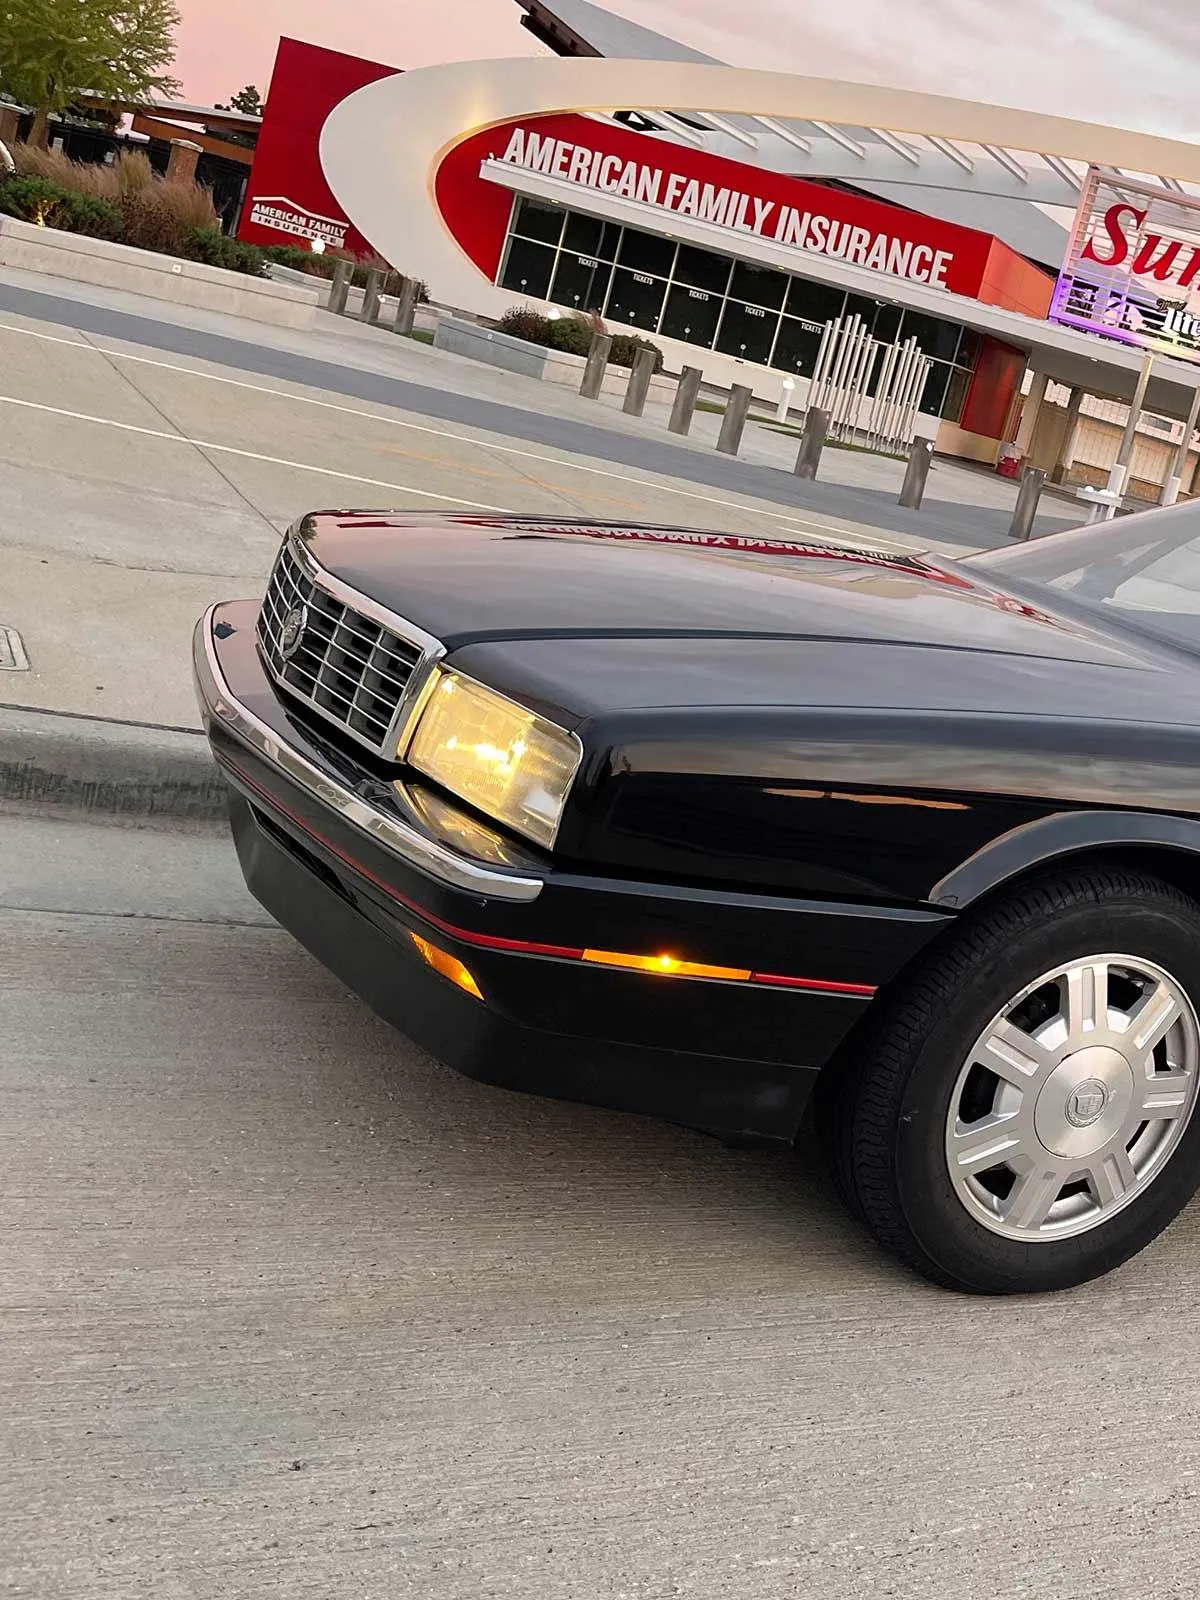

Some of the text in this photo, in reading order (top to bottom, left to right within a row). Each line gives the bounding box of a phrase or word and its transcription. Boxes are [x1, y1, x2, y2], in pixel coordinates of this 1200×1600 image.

[502, 127, 954, 291] AMERICAN FAMILY INSURANCE
[252, 203, 347, 238] AMERICAN FAMILY
[257, 216, 338, 244] INSURANCE
[578, 257, 599, 269] TICKETS
[633, 273, 654, 285] TICKETS
[689, 290, 709, 301] TICKETS
[745, 306, 765, 318] TICKETS
[801, 322, 822, 334] TICKETS
